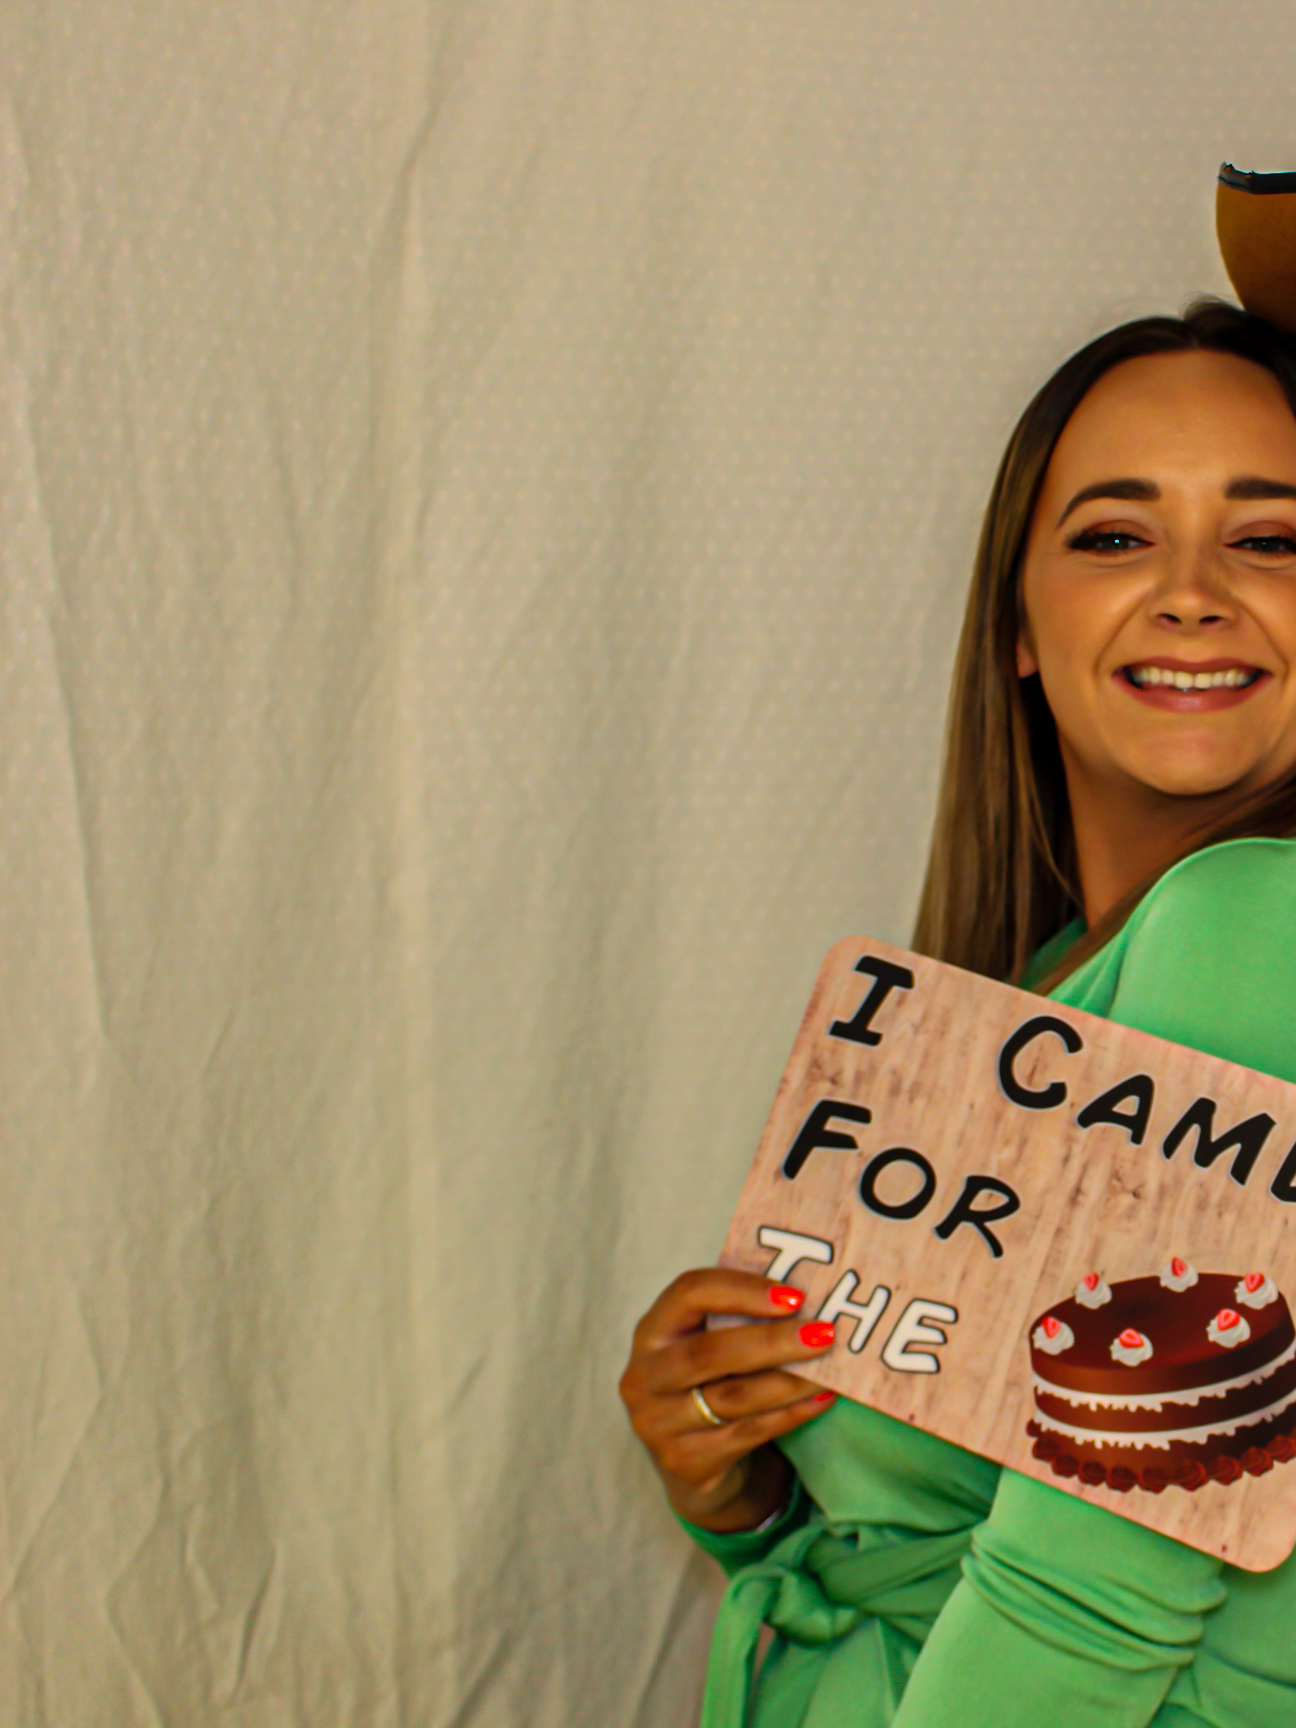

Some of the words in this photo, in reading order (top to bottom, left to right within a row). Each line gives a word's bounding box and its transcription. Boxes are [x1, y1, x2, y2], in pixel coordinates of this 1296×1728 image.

[828, 955, 915, 1047] I
[782, 1099, 1022, 1259] FOR
[757, 1226, 959, 1375] THE
